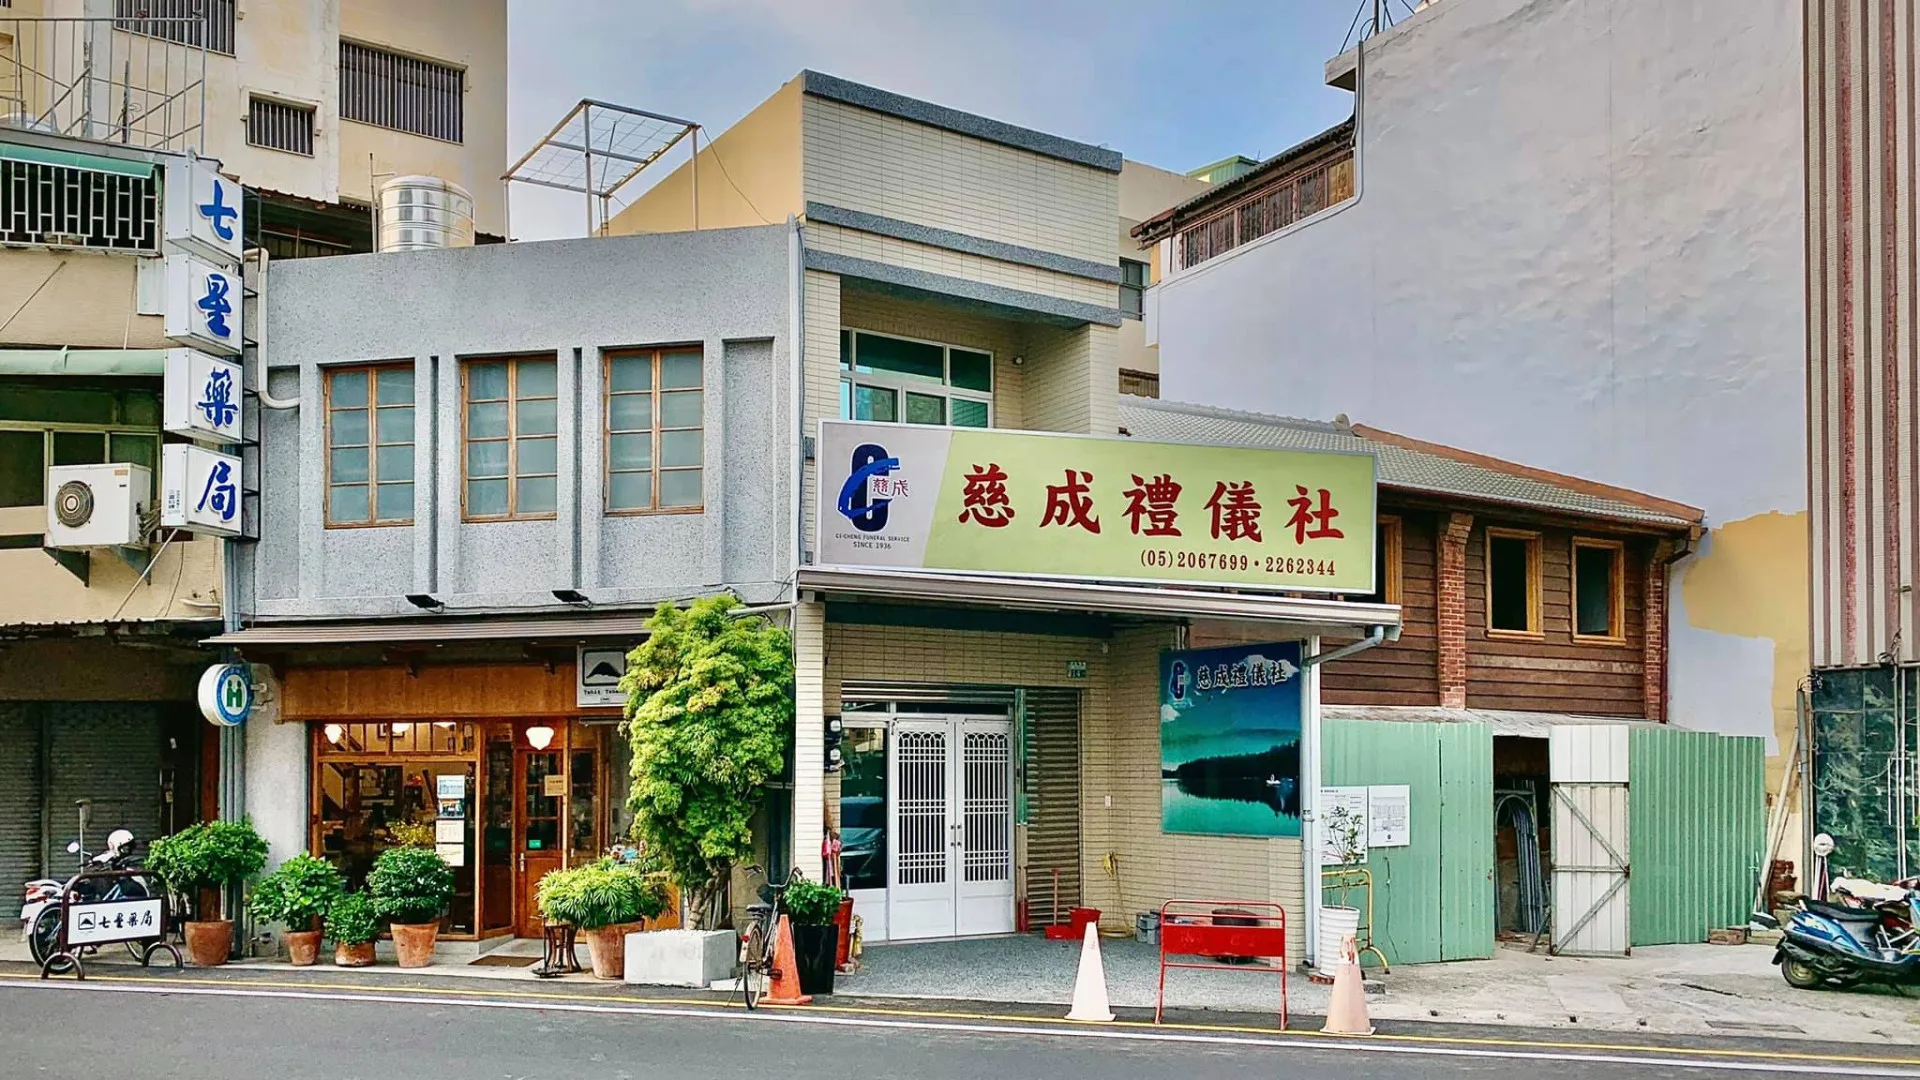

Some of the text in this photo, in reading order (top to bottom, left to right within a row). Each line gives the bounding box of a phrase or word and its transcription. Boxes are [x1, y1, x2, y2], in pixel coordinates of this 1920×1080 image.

[197, 179, 238, 520] 七星藥局
[873, 478, 908, 497] 慈成
[958, 462, 1345, 545] 慈成禮儀社
[853, 541, 892, 550] SINCE 1936
[863, 534, 886, 542] FUNERAL
[888, 535, 910, 543] SERVICE
[1196, 661, 1287, 690] 慈成禮儀社
